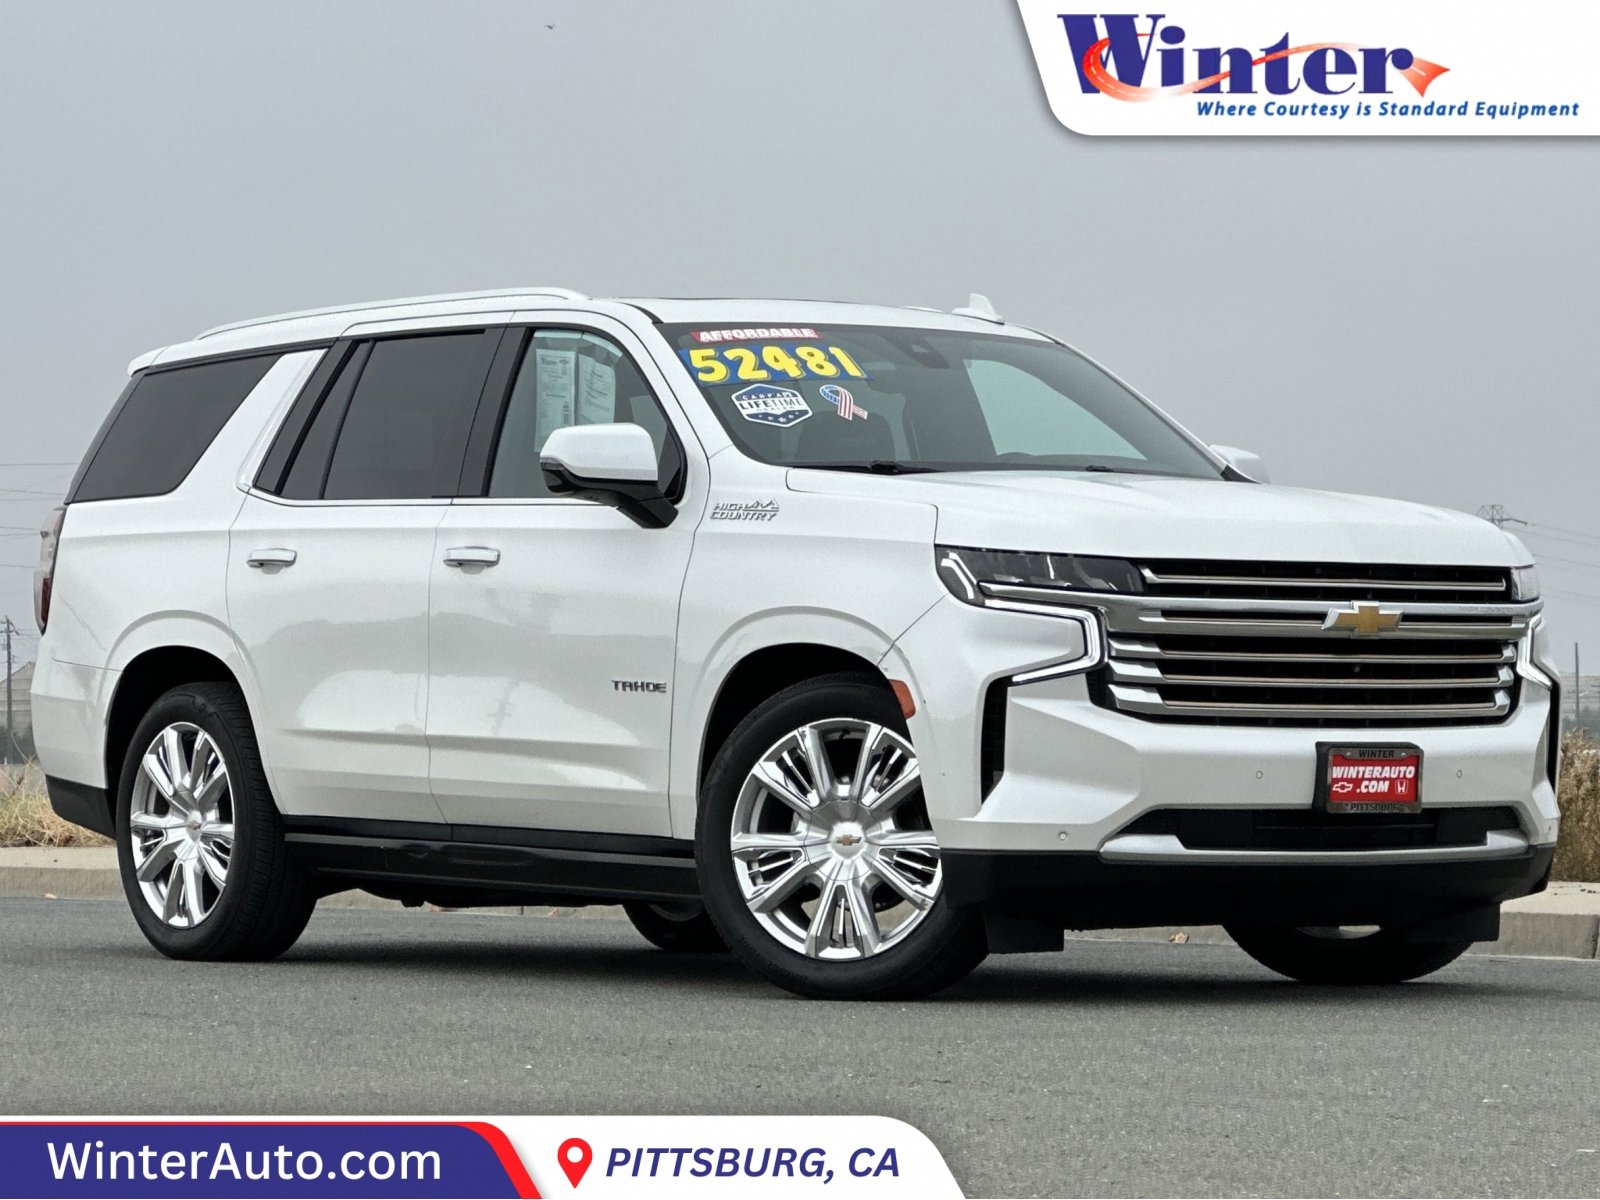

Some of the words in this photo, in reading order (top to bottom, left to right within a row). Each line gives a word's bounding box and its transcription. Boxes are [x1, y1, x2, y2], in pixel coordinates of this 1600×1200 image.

[700, 328, 818, 342] AFFORDABLE
[689, 346, 867, 382] 52481
[740, 399, 804, 410] LIFETIME
[713, 503, 743, 511] HIGH
[710, 511, 777, 521] COUNTRY
[611, 680, 667, 693] TAHOE
[1359, 750, 1394, 758] WINTER
[1332, 766, 1415, 778] WINTERAUTO
[1356, 780, 1389, 793] .COM
